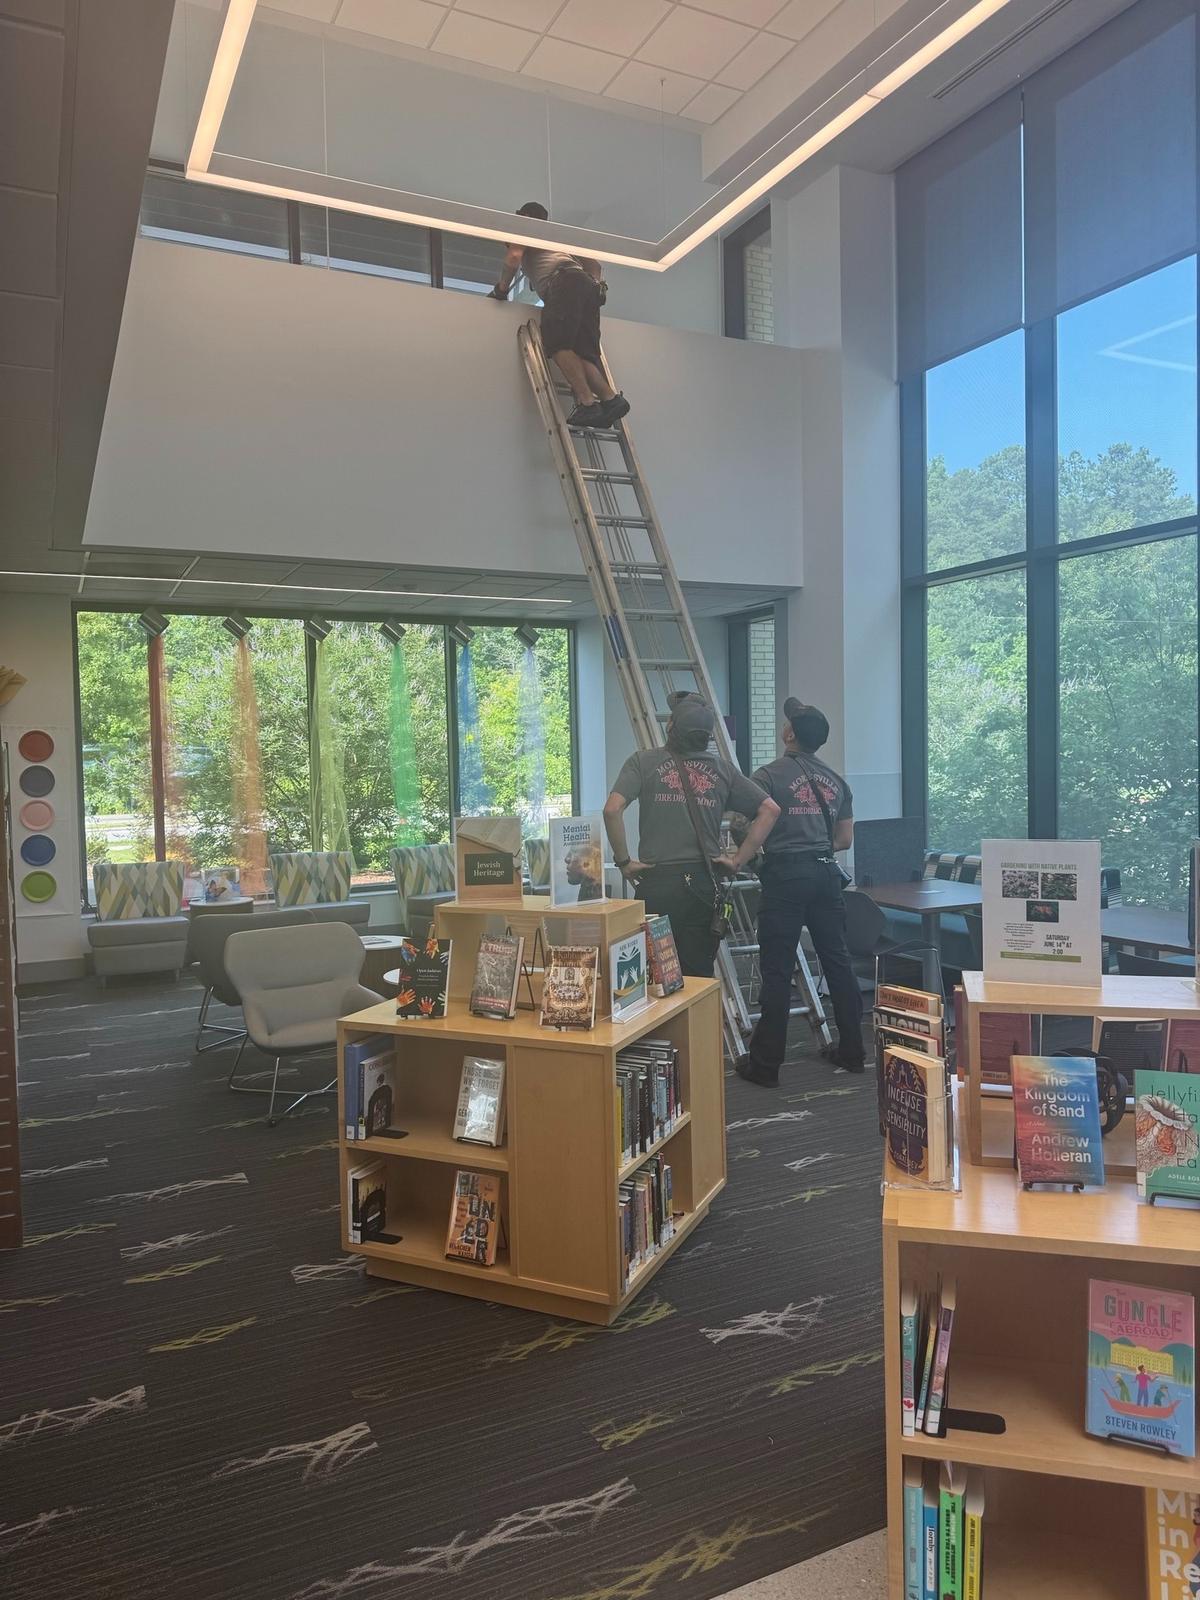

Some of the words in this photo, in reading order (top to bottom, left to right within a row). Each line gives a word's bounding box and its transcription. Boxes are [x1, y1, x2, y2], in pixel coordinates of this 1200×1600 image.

[655, 759, 720, 783] MORISVILLE
[788, 773, 839, 794] MORSVILLE
[654, 793, 672, 802] FIRE
[673, 793, 717, 808] DEPMENT
[563, 823, 591, 834] Mental
[563, 832, 591, 842] Health
[477, 861, 501, 869] Jewish
[473, 869, 505, 877] Heritage
[477, 1079, 499, 1090] FORGET
[1043, 1074, 1068, 1087] The
[1025, 1087, 1091, 1103] Kingdom
[1032, 1104, 1048, 1117] of
[1050, 1104, 1085, 1118] Sand
[1031, 1133, 1090, 1148] Andrew
[1031, 1147, 1091, 1163] Holleran
[1104, 1294, 1183, 1333] GUNCLE
[1114, 1324, 1170, 1338] ABROAD
[1105, 1415, 1138, 1432] STEVEN
[1140, 1422, 1177, 1440] ROWLEY
[927, 1525, 935, 1552] Hornby
